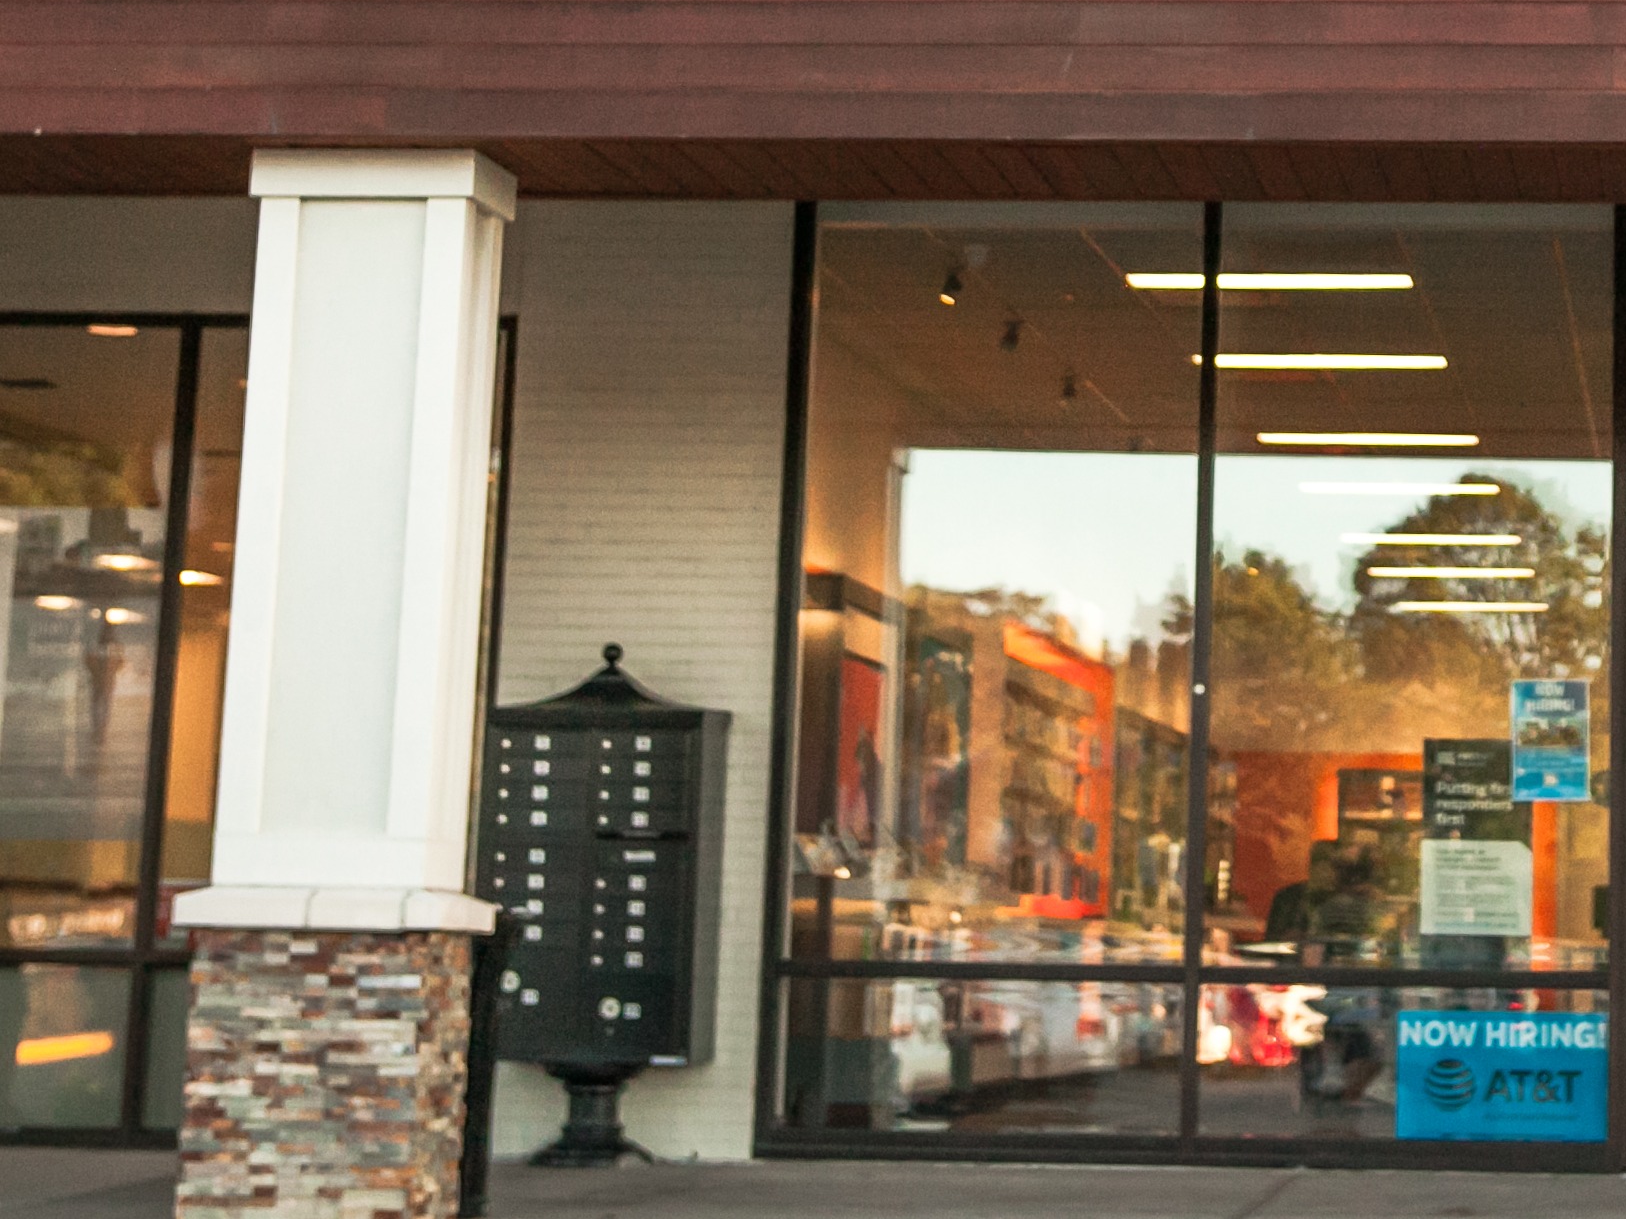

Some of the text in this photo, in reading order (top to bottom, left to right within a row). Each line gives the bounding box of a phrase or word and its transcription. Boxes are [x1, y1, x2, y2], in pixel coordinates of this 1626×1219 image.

[1400, 1020, 1606, 1049] NOW HIRING!
[1482, 1069, 1583, 1103] AT&T
